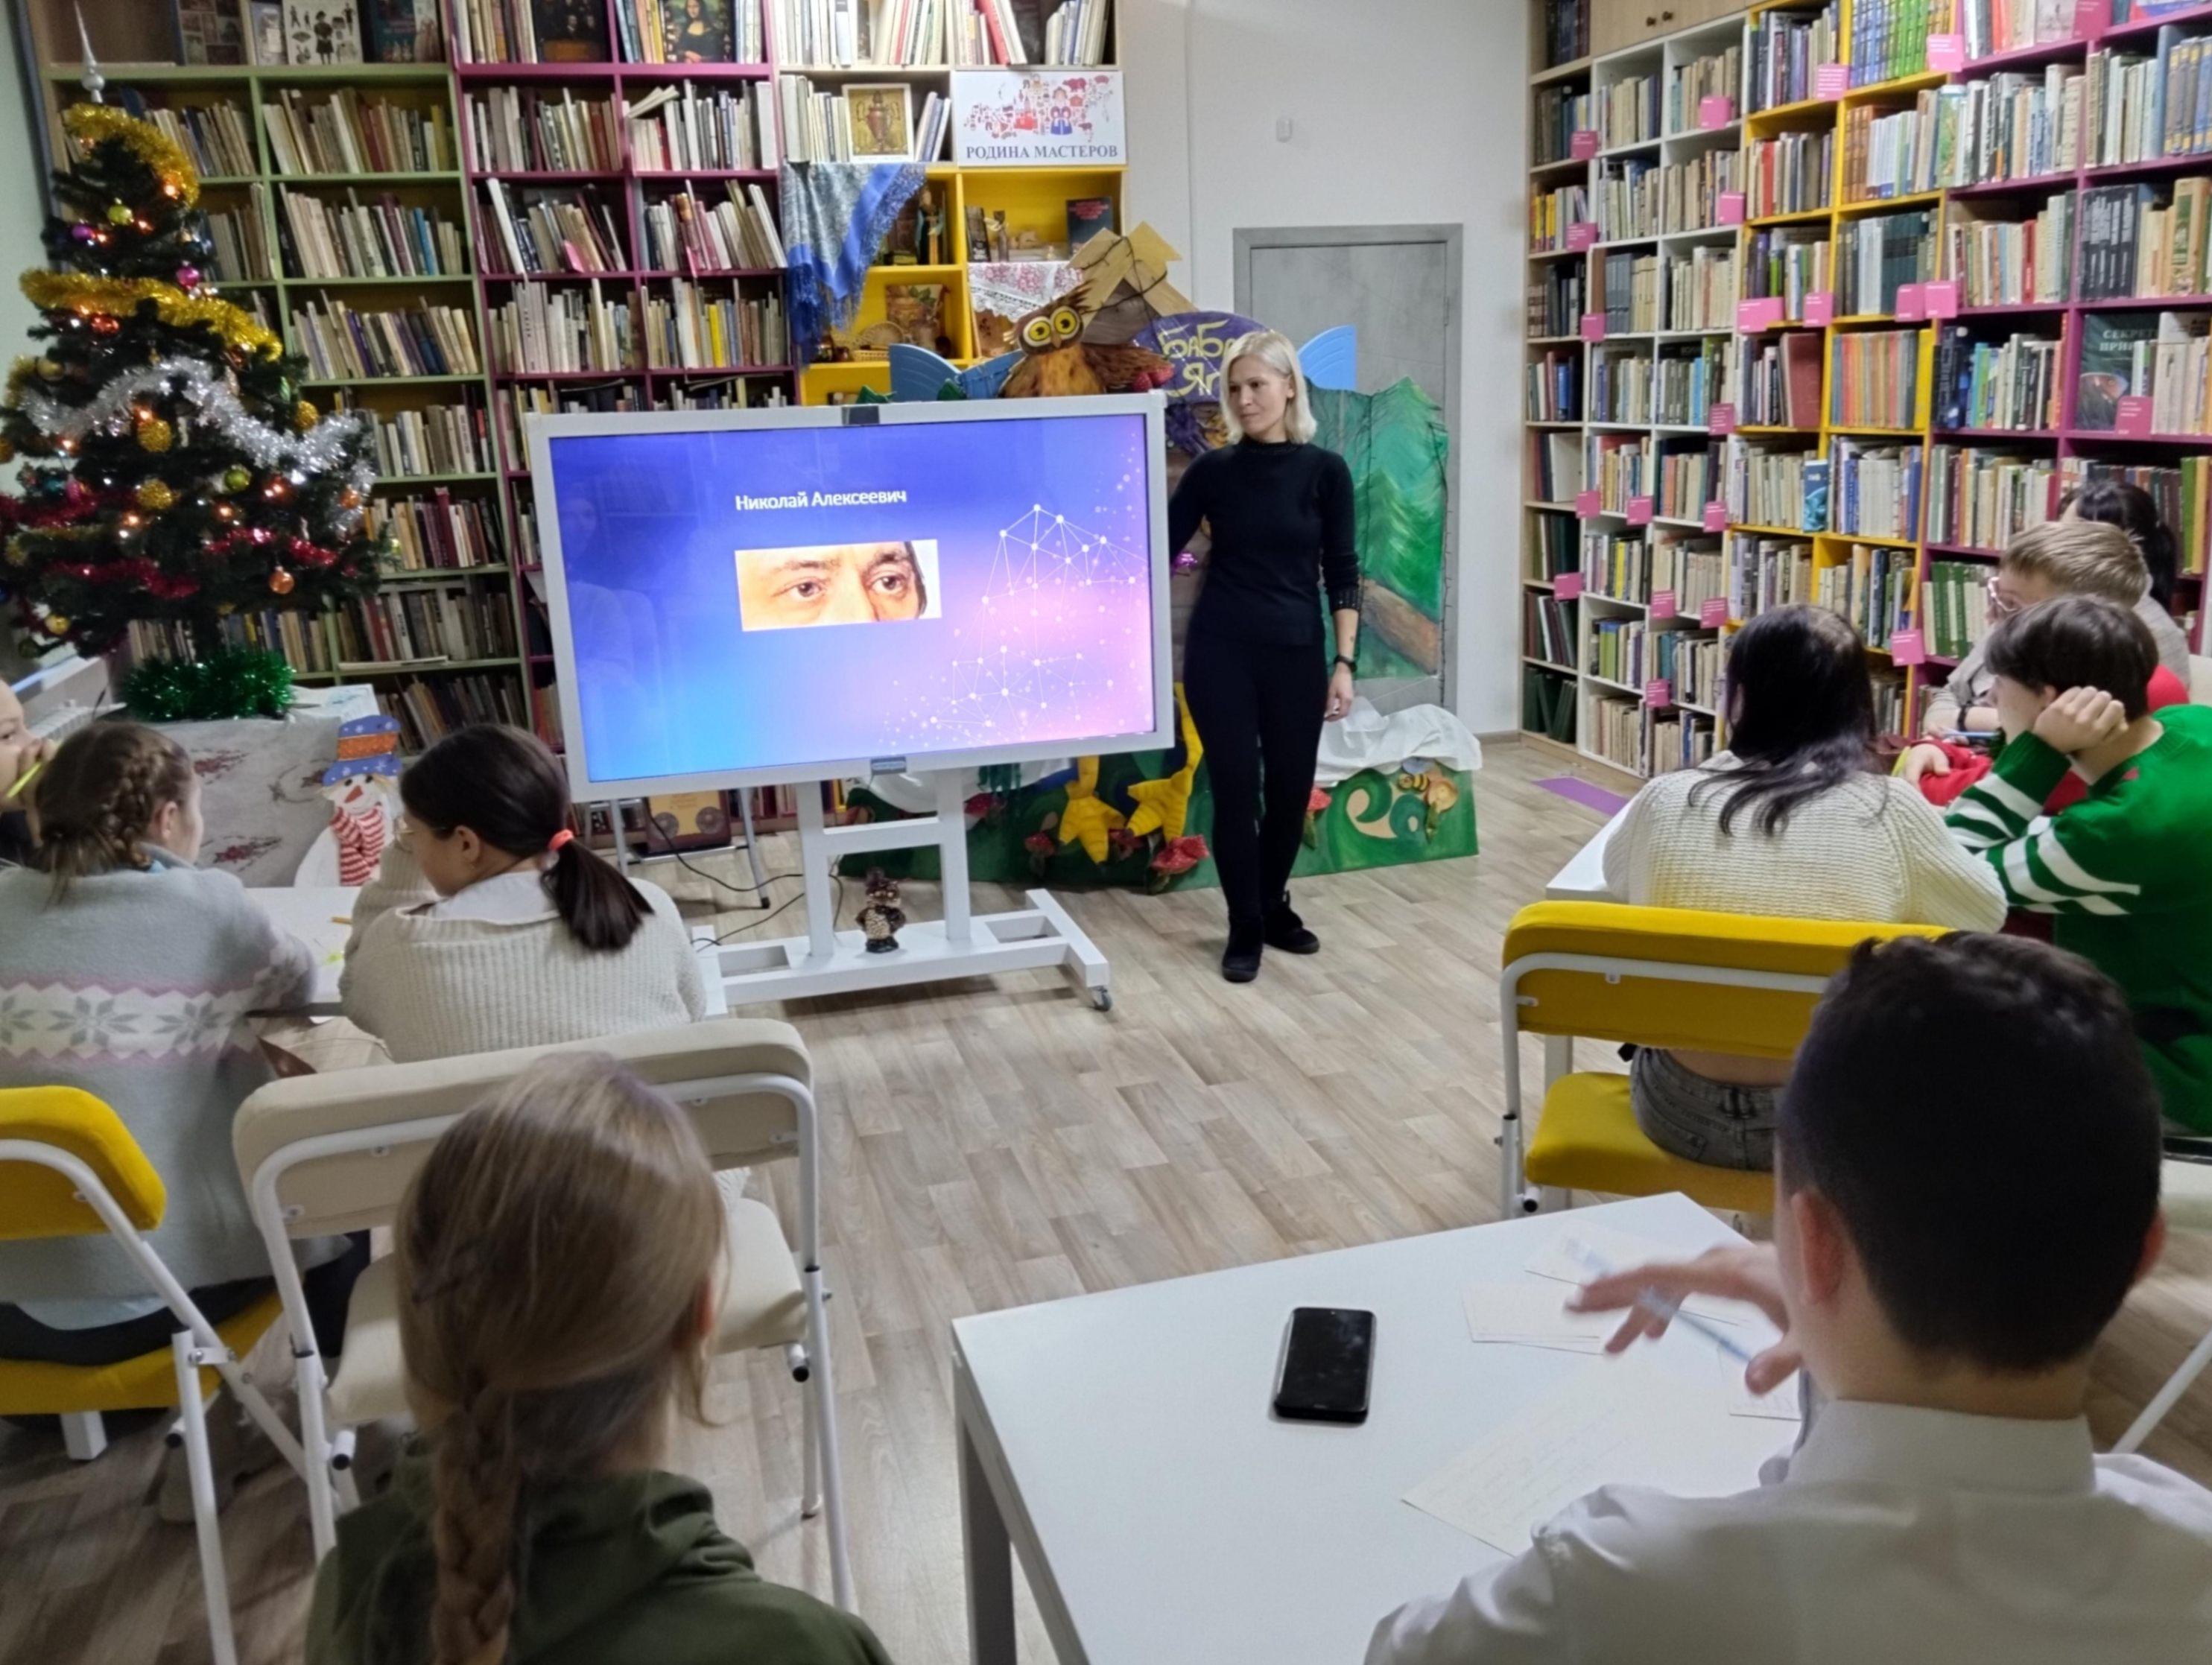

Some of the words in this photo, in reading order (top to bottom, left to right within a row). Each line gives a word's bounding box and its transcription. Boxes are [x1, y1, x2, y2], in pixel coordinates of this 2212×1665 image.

[966, 146, 1030, 160] РОДИНА
[1035, 145, 1118, 159] МАСТЕРОВ
[2102, 328, 2158, 340] СЕКРЕТ
[1167, 361, 1221, 397] ЯГ
[735, 491, 808, 511] Николай
[811, 490, 907, 507] Алексеевич
